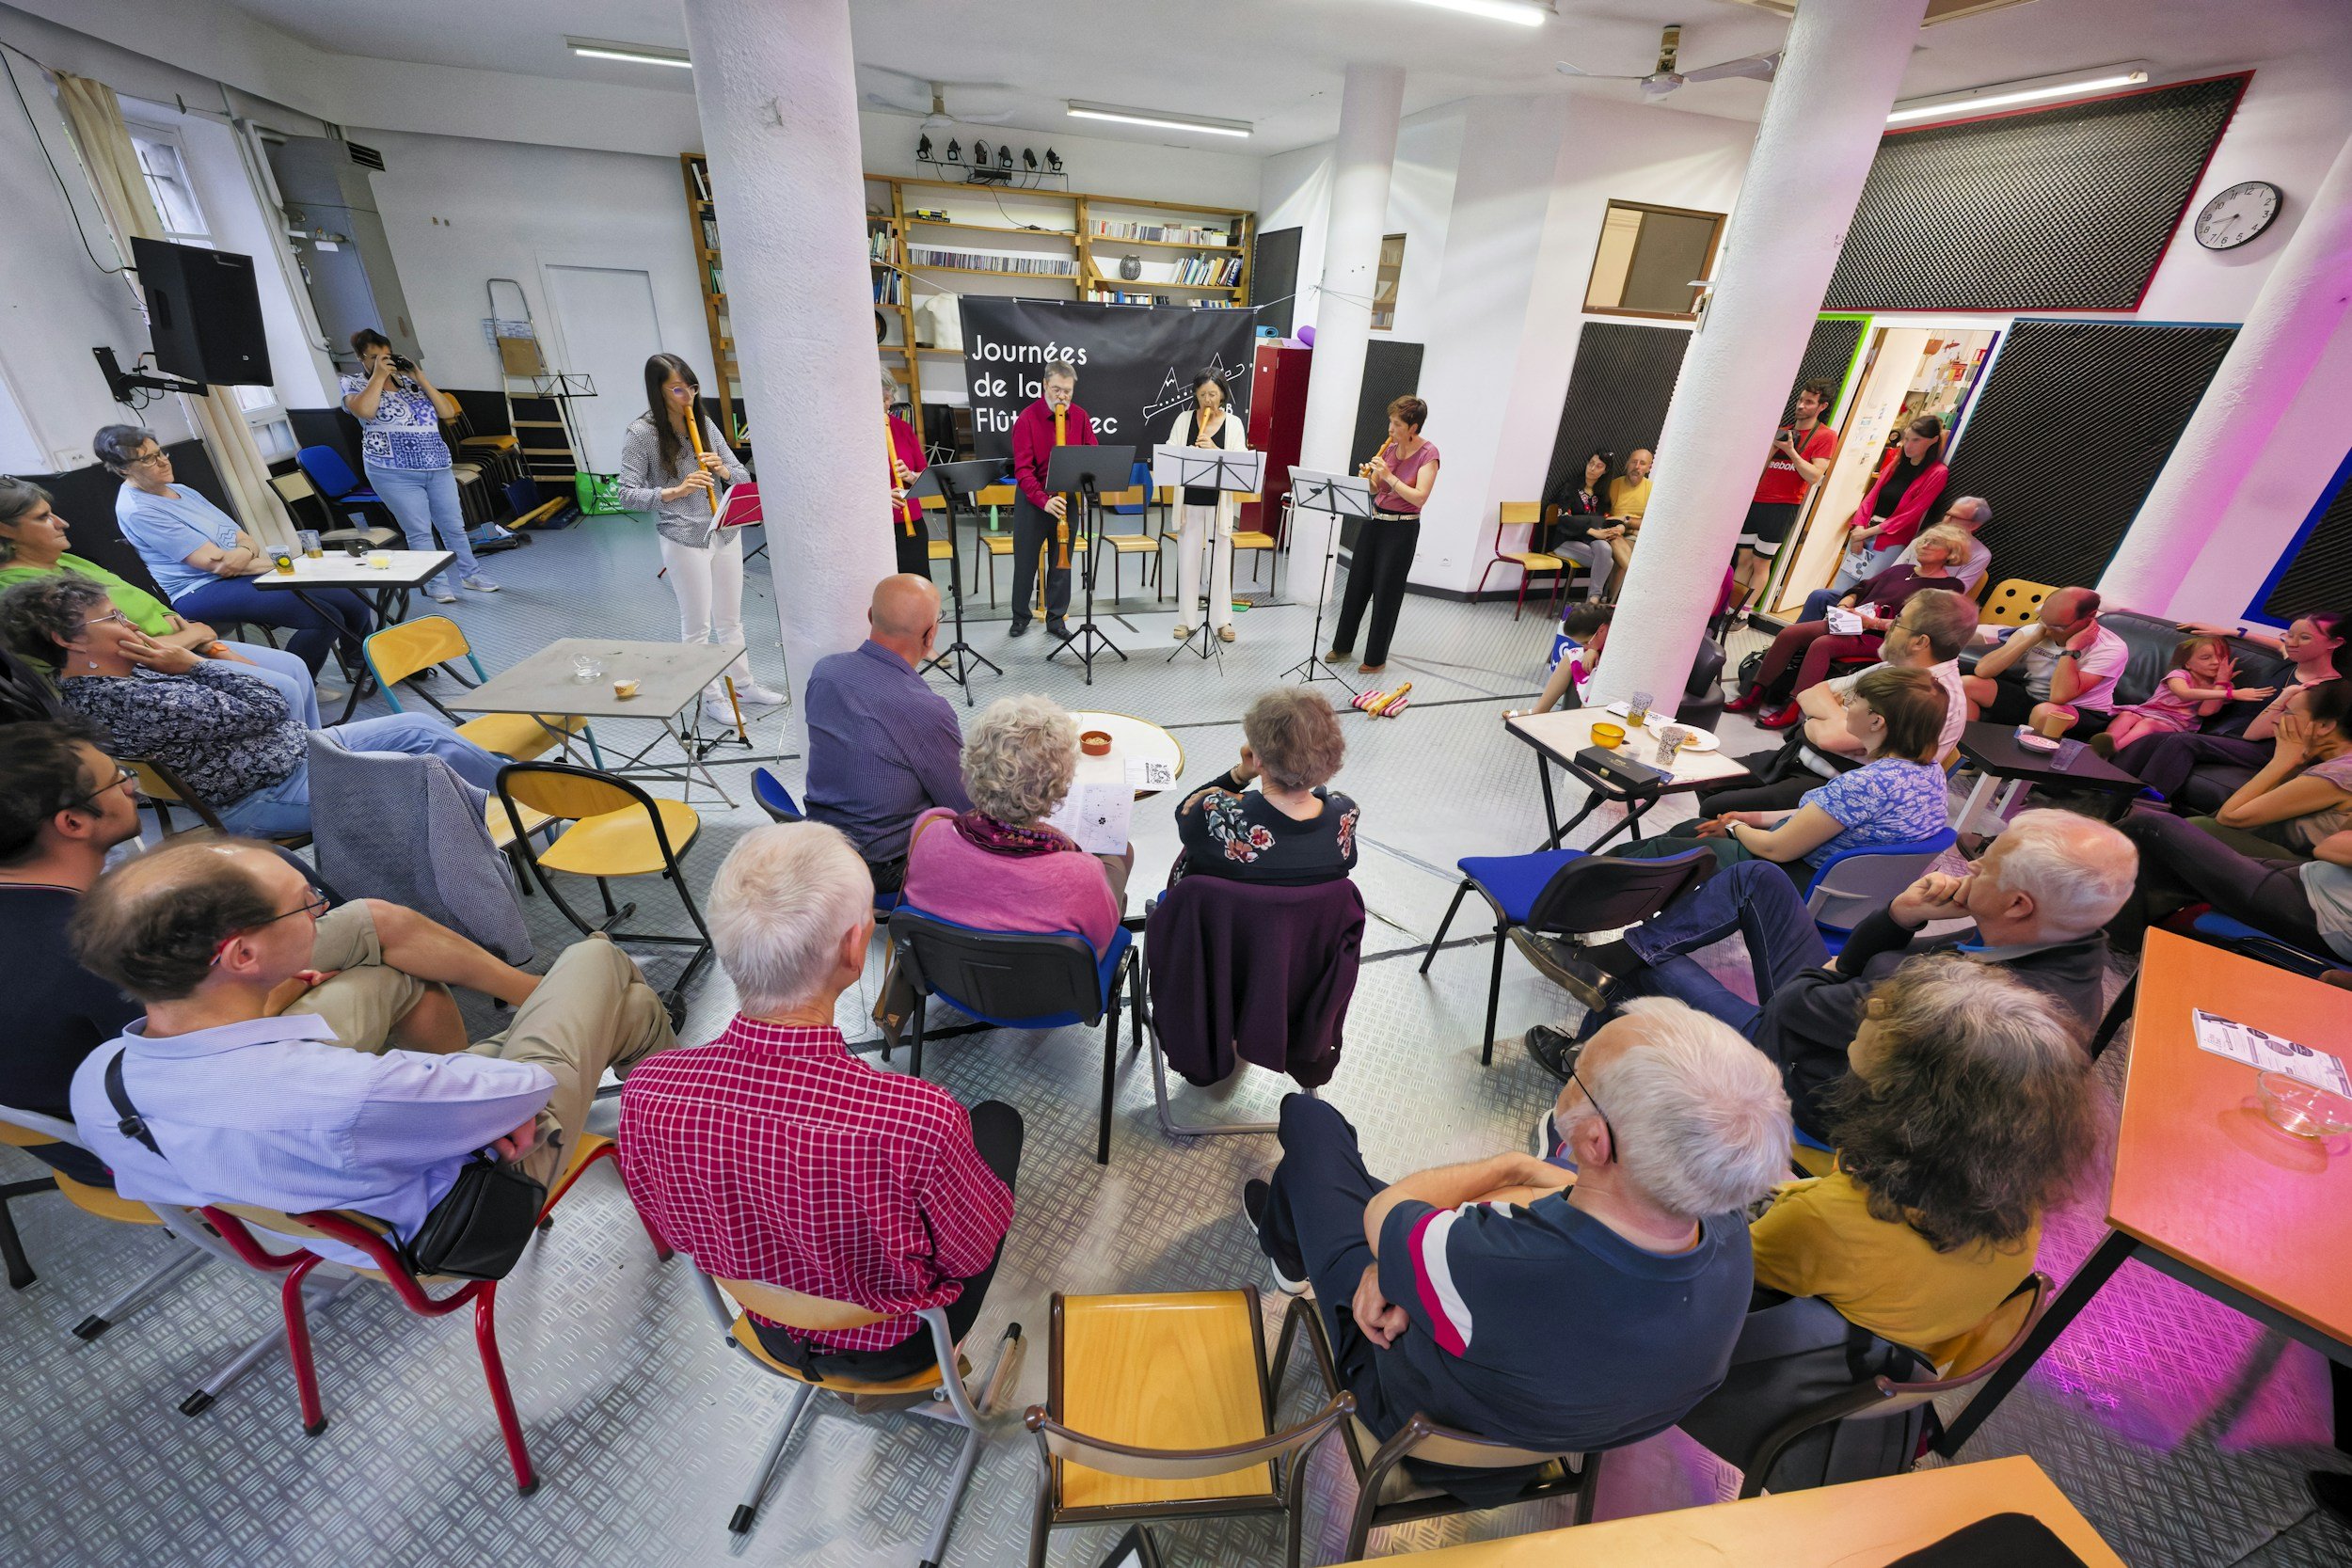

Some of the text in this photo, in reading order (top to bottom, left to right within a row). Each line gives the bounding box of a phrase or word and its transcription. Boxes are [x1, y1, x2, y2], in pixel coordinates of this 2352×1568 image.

[2244, 183, 2255, 195] 12
[2259, 189, 2265, 198] 1
[2230, 192, 2238, 200] 11
[2215, 201, 2225, 210] 10
[2262, 210, 2269, 218] 3
[2235, 232, 2243, 241] 5
[972, 334, 1088, 366] Journées
[974, 372, 1042, 399] de la
[976, 406, 1119, 435] Flût ec
[1769, 460, 1796, 471] eebok
